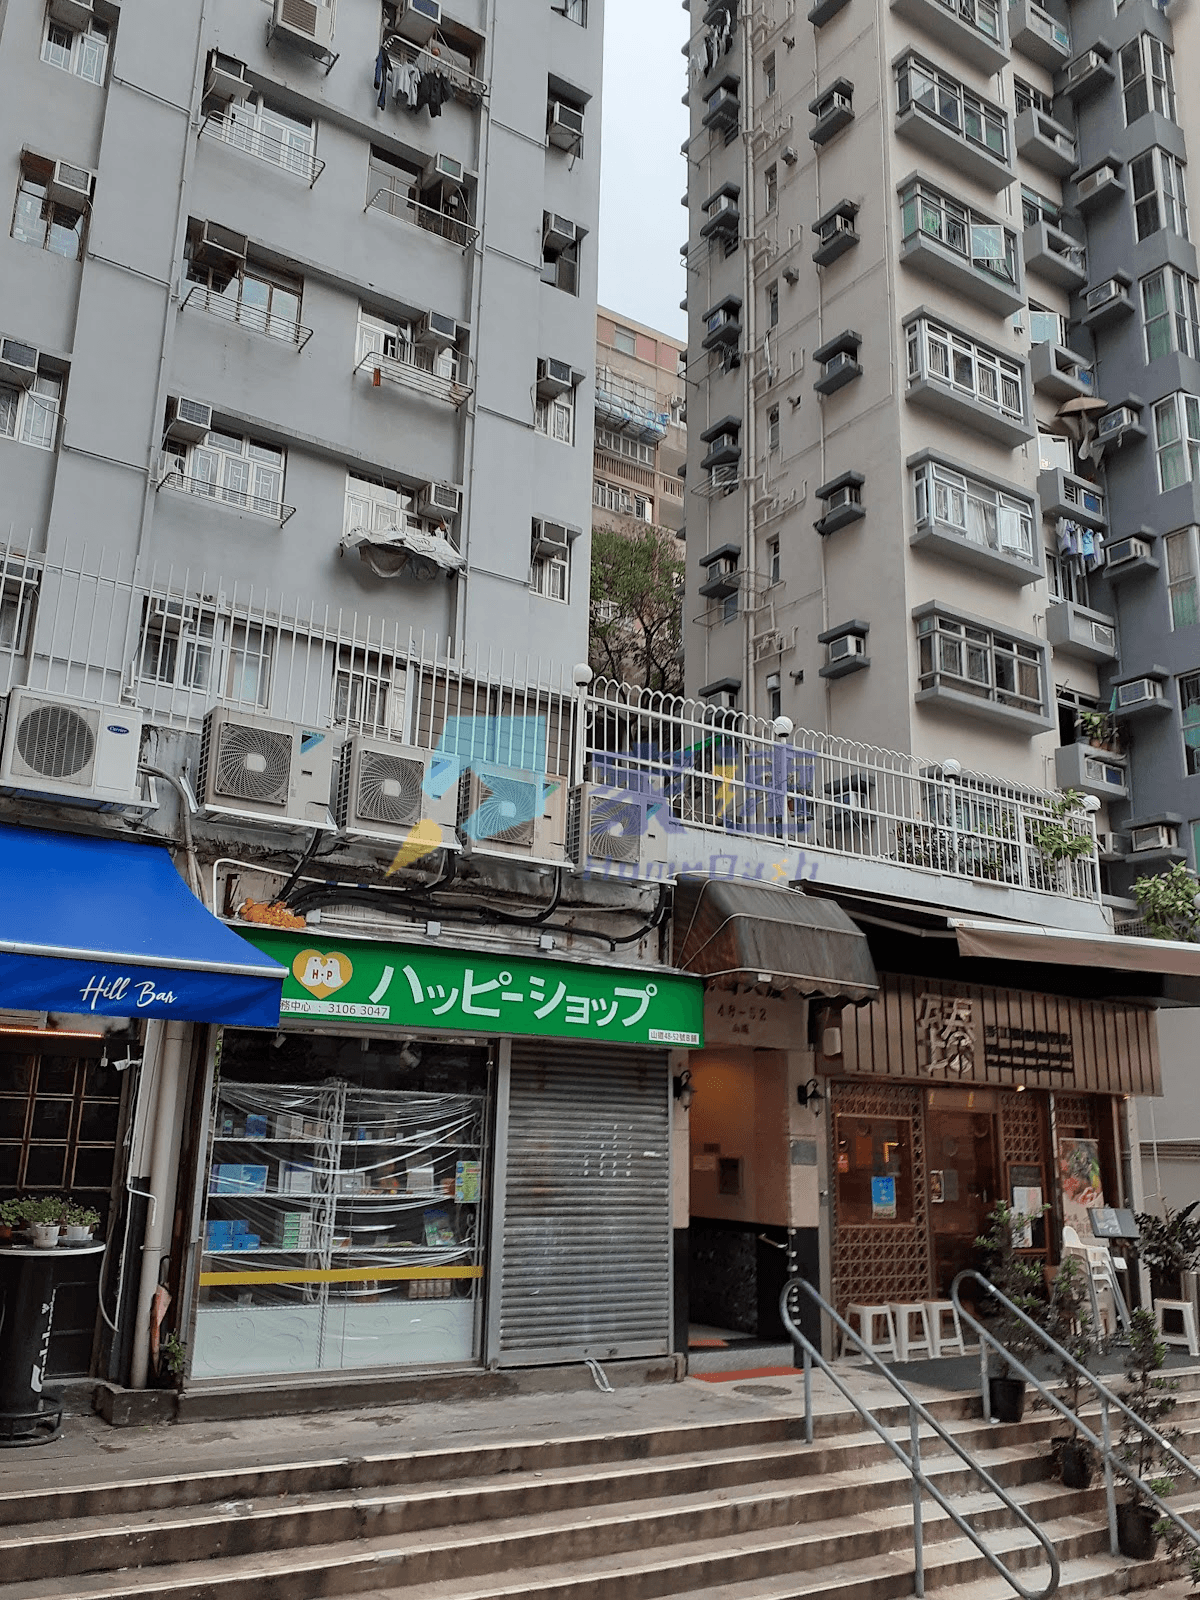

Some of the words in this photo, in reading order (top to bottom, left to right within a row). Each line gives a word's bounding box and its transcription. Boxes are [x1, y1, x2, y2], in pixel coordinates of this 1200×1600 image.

[79, 975, 131, 1010] Hill
[134, 981, 178, 1008] Bar
[327, 1003, 356, 1015] 3106
[360, 1006, 388, 1017] 3047
[368, 964, 658, 1027] ハッピーショップ
